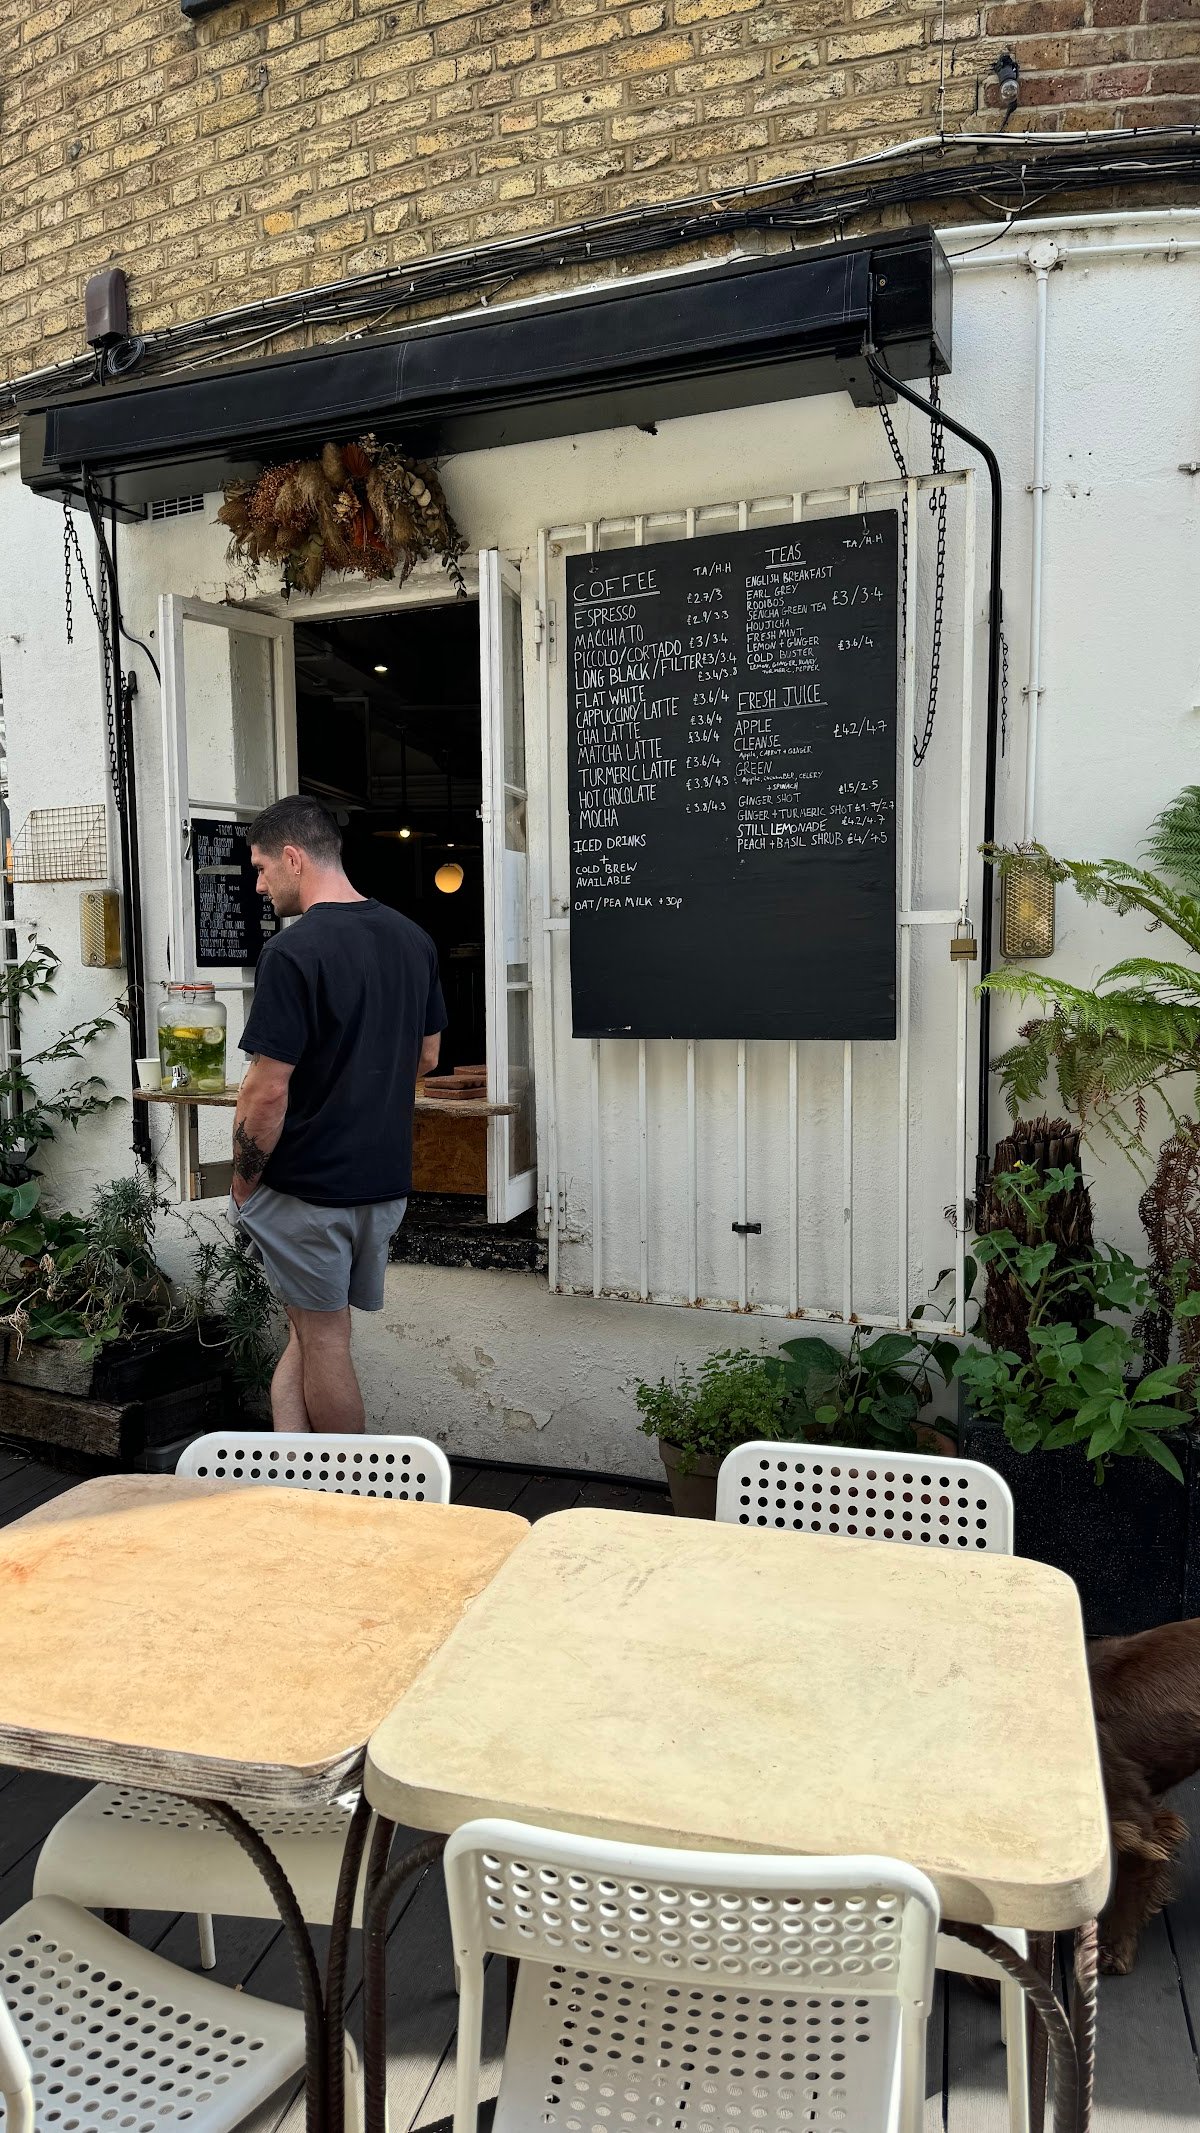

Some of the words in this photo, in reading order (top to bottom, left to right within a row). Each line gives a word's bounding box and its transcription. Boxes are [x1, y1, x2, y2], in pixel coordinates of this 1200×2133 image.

[765, 544, 802, 564] TEAS
[573, 570, 656, 601] COFFEE
[746, 574, 779, 587] ENGLISH
[783, 566, 833, 584] BREAKFAST
[746, 589, 770, 600] EARL
[774, 583, 799, 597] GREY
[746, 597, 784, 611] ROOIBOS
[747, 608, 779, 622] SENCHA
[782, 604, 807, 616] GREEN
[810, 602, 826, 612] TEA
[574, 605, 636, 629] ESPRESSO
[746, 618, 790, 632] HOUJICHA
[574, 624, 644, 651] MACCHIATO
[746, 630, 776, 643] FRESH
[779, 628, 804, 638] MINT
[746, 640, 776, 653] LEMON
[787, 636, 819, 647] GINGER
[574, 639, 682, 669] PICCOLO/CORTADO
[747, 653, 773, 664] COLD
[780, 648, 814, 660] BUSTER
[574, 669, 605, 690] LONG
[575, 691, 606, 709] FLAT
[609, 685, 646, 705] WHITE
[738, 689, 776, 711] FRESH
[782, 684, 820, 707] JUICE
[577, 729, 599, 746] CHAI
[604, 722, 641, 743] LATTE
[734, 719, 772, 736] APPLE
[578, 744, 622, 765] MATCHA
[626, 738, 662, 761] LATTE
[734, 734, 781, 751] CLEANSE
[578, 765, 640, 787] TURMERIC
[642, 759, 677, 781] LATTE
[736, 761, 772, 776] GREEN
[799, 771, 823, 779] CELERY
[579, 789, 600, 809] HOT
[603, 784, 657, 806] CHOCOLATE
[738, 795, 773, 807] GINGER
[776, 793, 801, 804] SHOT
[579, 809, 619, 829] MOCHA
[737, 808, 772, 821] GINGER
[778, 807, 825, 820] TURMERIC
[830, 804, 853, 815] SHOT
[737, 824, 768, 838] STILL
[771, 818, 828, 835] LEMONADE
[574, 839, 602, 853] ICED
[607, 834, 646, 849] DRINKS
[738, 838, 766, 852] PEACH
[776, 836, 806, 849] BASIL
[811, 832, 843, 846] SHRUB
[576, 865, 600, 875] COLD
[605, 862, 638, 874] BREW
[600, 855, 609, 864] +
[576, 875, 631, 888] AVAILABLE
[575, 897, 621, 911] OAT/PEA
[625, 897, 653, 907] MILK
